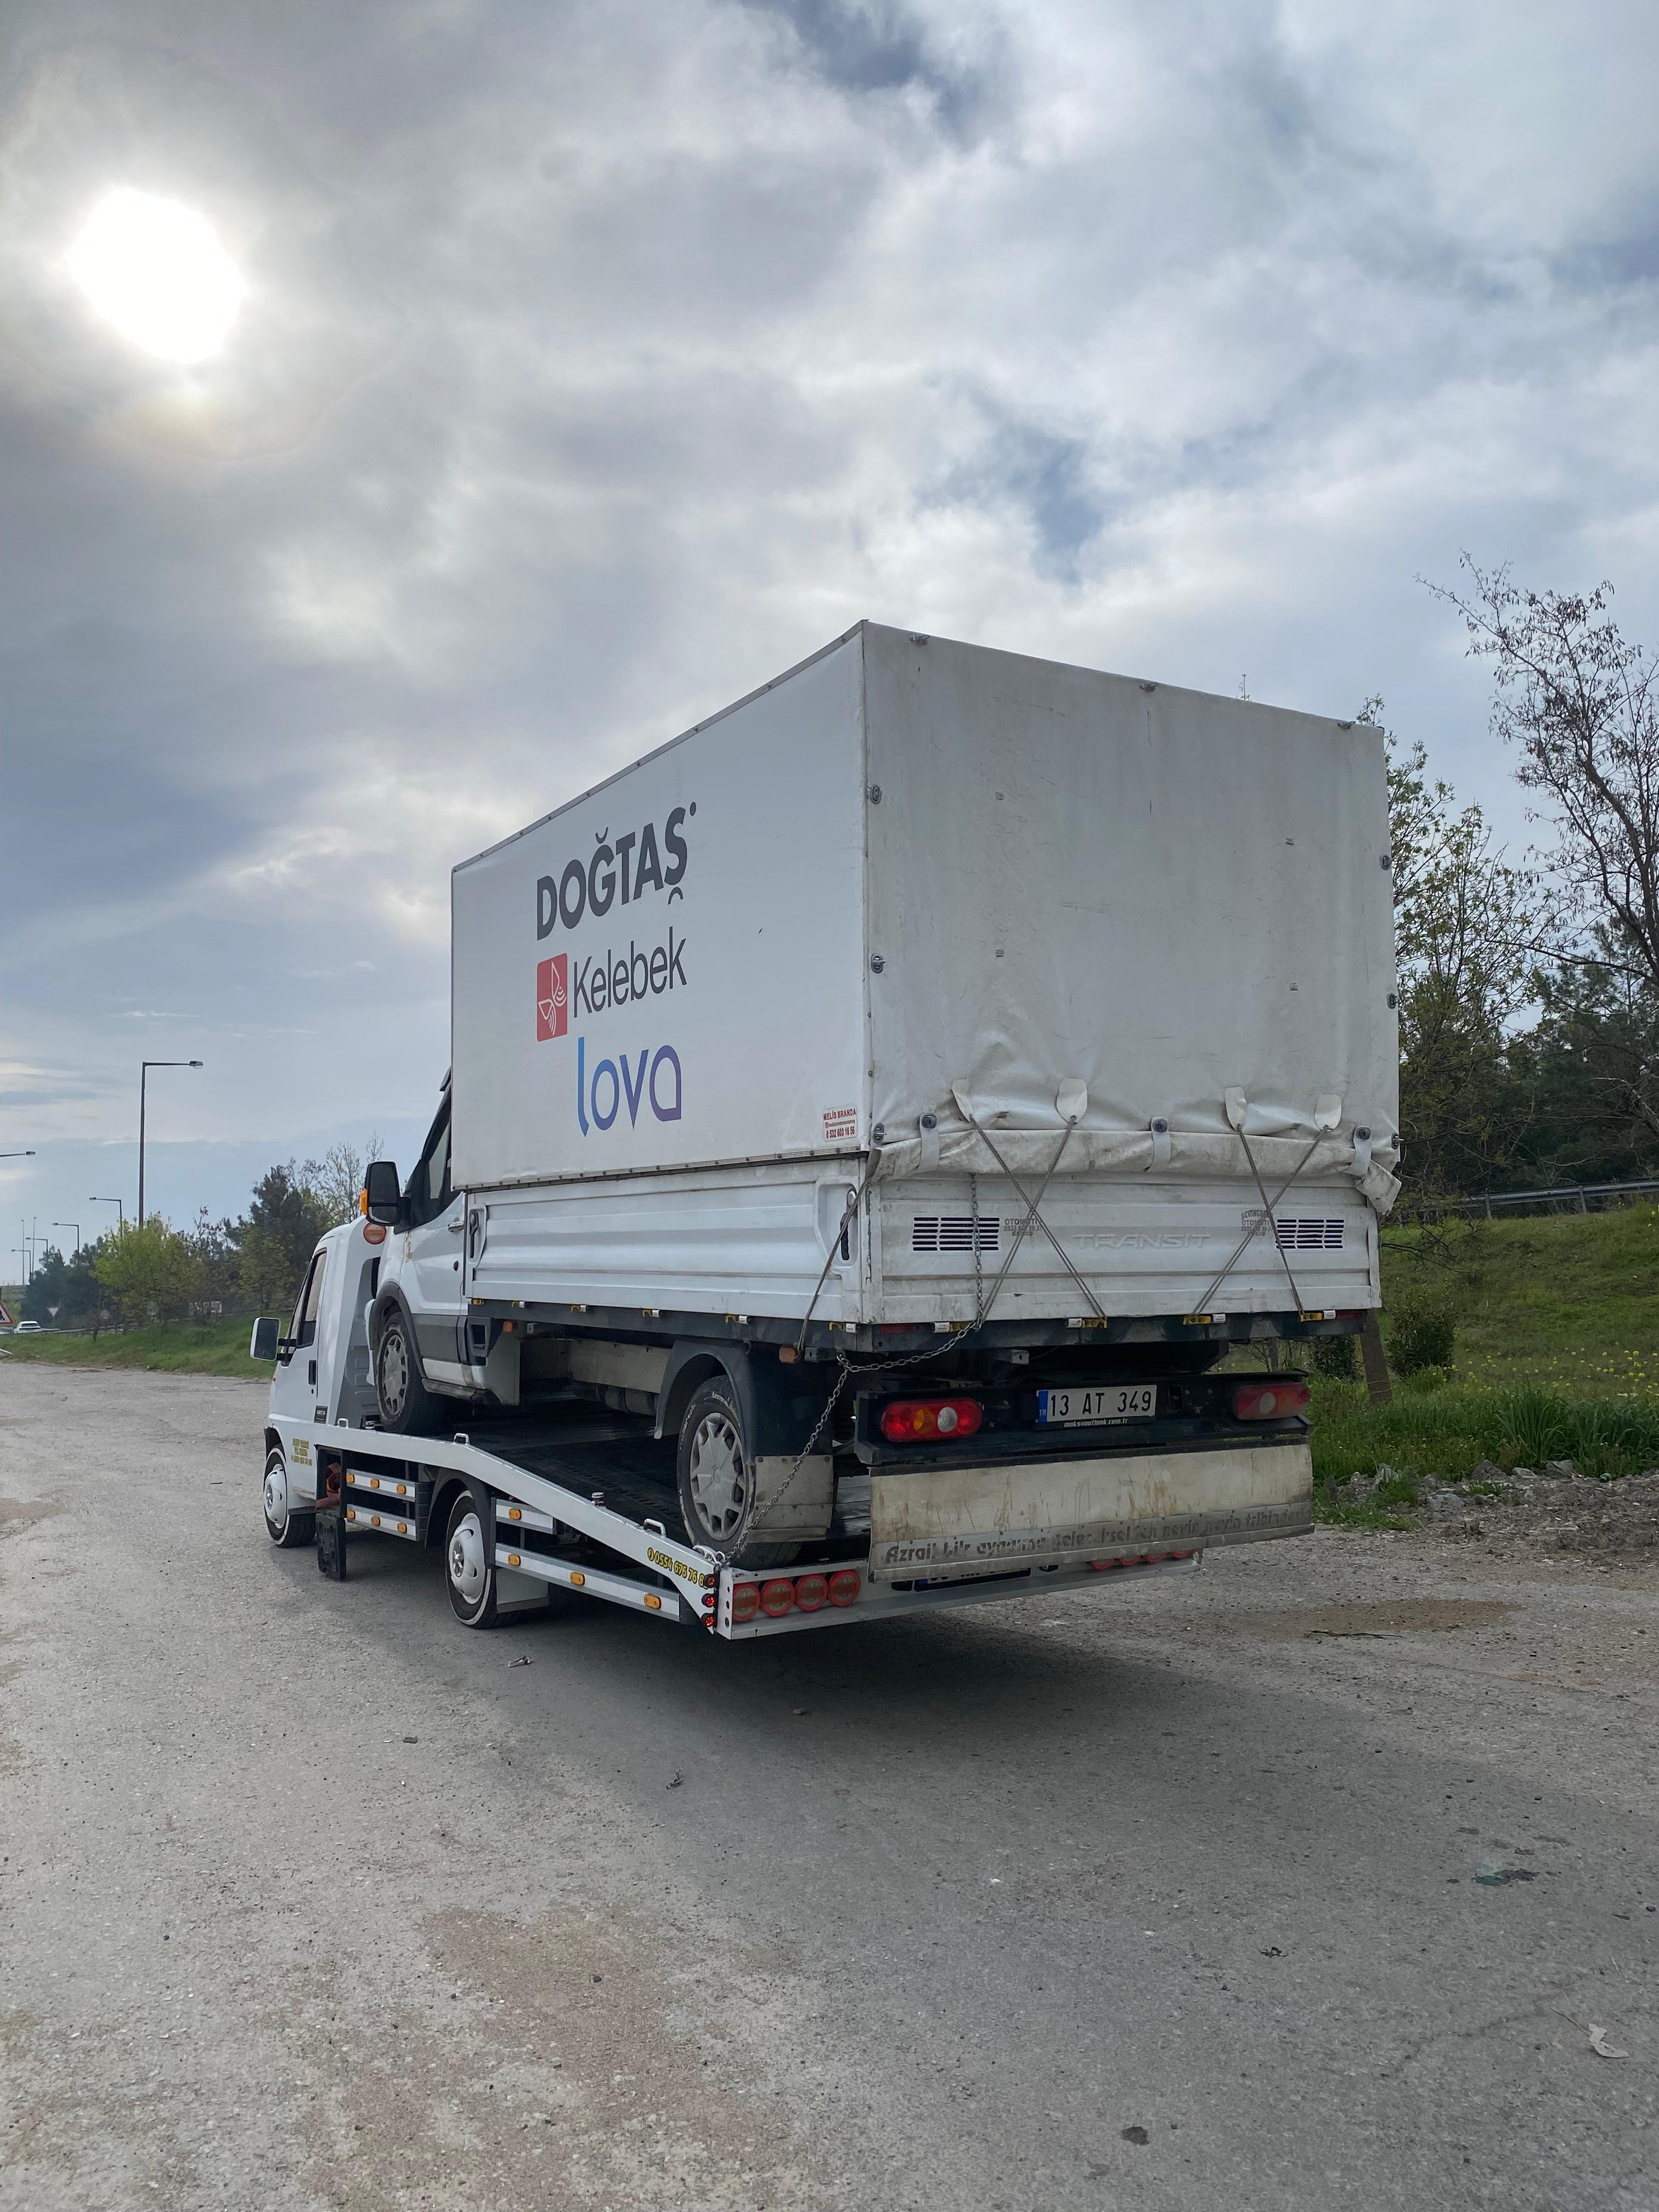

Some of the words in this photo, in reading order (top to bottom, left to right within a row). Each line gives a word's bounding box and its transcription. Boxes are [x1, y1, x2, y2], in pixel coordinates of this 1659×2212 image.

[537, 806, 688, 941] DOĞTAŞ
[574, 926, 687, 1018] Kelebek
[578, 1037, 682, 1137] lova
[823, 1110, 837, 1120] MELİS
[837, 1108, 856, 1118] BRANDA
[1073, 1234, 1211, 1249] TRANSIT
[1051, 1395, 1069, 1416] 13
[1082, 1393, 1105, 1414] AT
[1117, 1391, 1152, 1413] 349
[654, 1550, 673, 1572] 0554
[674, 1560, 688, 1578] 676
[688, 1567, 698, 1584] 76
[698, 1573, 709, 1590] 8
